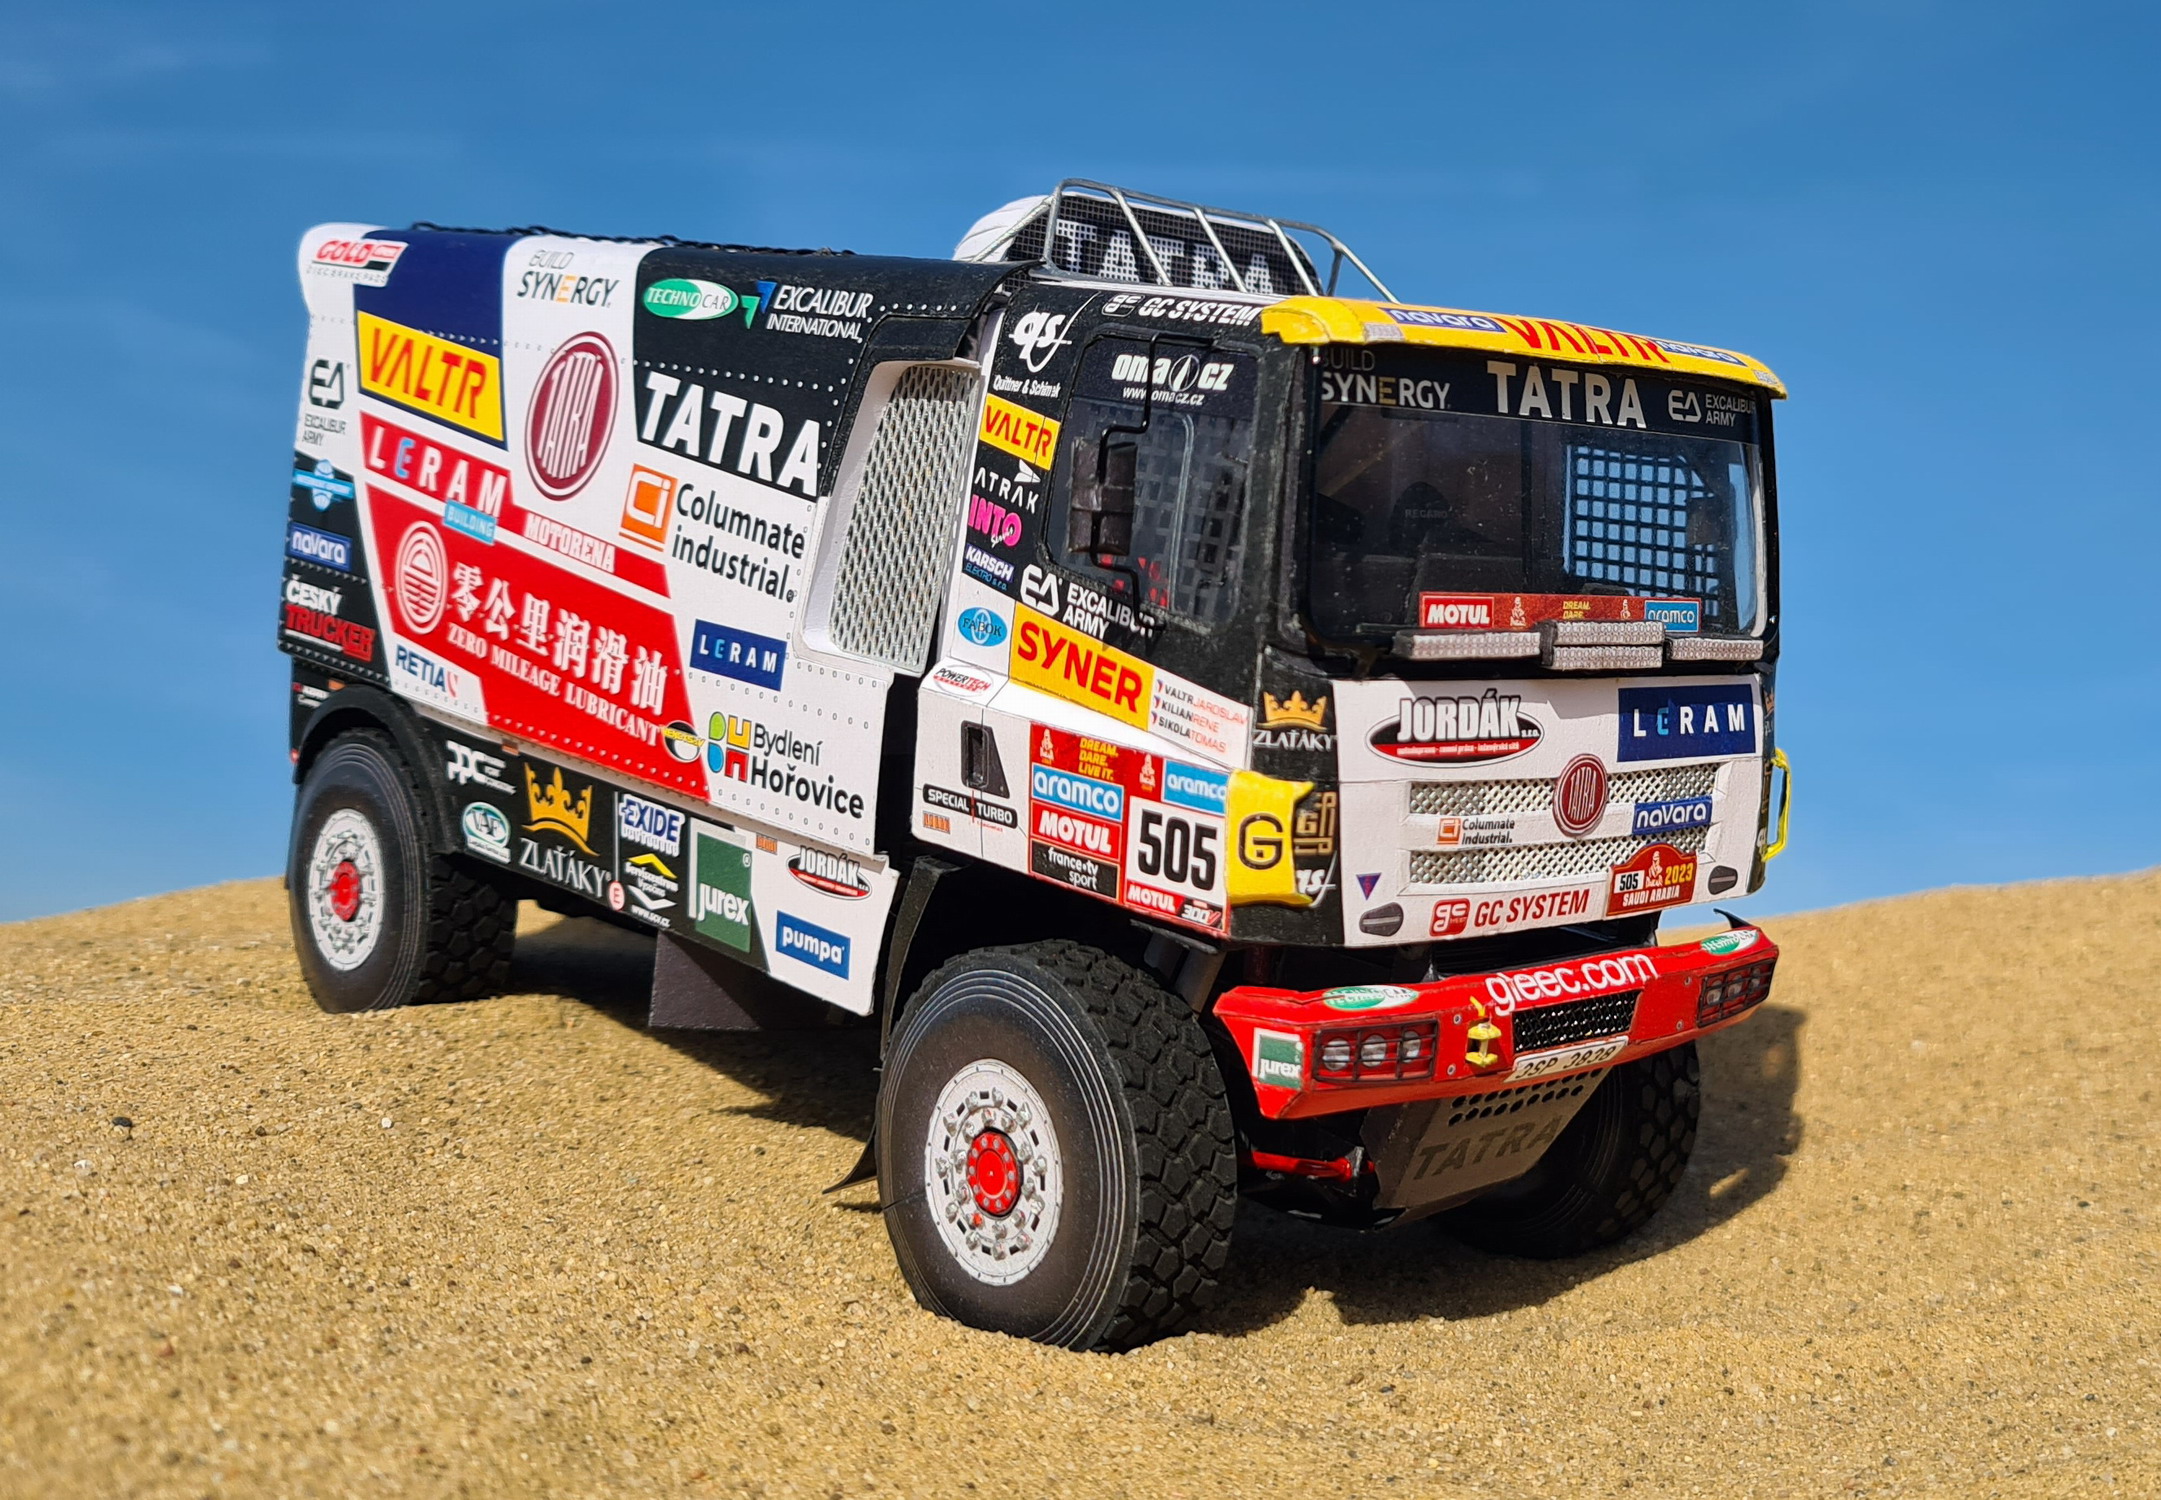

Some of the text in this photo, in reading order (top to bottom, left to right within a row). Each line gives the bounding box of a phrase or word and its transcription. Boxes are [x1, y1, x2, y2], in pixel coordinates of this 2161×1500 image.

[1056, 218, 1275, 295] TATRA
[517, 271, 619, 306] SYNERGY
[773, 285, 874, 318] EXCALIBUR
[766, 314, 861, 340] INTERNATIONAL
[1138, 297, 1175, 317] GC
[1168, 299, 1263, 326] SYSTEM
[1497, 317, 1670, 363] VALTR
[369, 327, 488, 419] VALTR
[1322, 371, 1450, 410] SYNERGY
[1486, 361, 1647, 429] TATRA
[641, 370, 820, 497] TATRA
[984, 405, 1053, 458] VALTR
[1705, 410, 1736, 428] ARMY
[369, 424, 508, 518] LERAM
[974, 466, 1040, 515] ATRAK
[447, 507, 495, 540] BUILDING
[676, 483, 806, 560] Columnate
[968, 494, 1022, 547] INTO
[523, 514, 617, 574] MOTORENA
[965, 546, 1015, 582] KARSCH
[286, 574, 342, 614] ČESKÝ
[1426, 604, 1491, 624] MOTUL
[284, 604, 376, 657] TRUCKER
[450, 562, 668, 716] 零公里润滑油
[963, 617, 1002, 637] FABOK
[1062, 604, 1110, 640] ARMY
[395, 644, 447, 693] RETIA
[699, 634, 778, 674] LERAM
[1017, 621, 1143, 714] SYNER
[447, 621, 488, 659] ZERO
[490, 643, 561, 697] MILEAGE
[564, 682, 661, 747] LUBRICANT
[1397, 688, 1521, 742] JORDÁK
[1632, 703, 1745, 738] LERAM
[753, 723, 824, 767] Bydlení
[751, 754, 865, 819] Hořovice
[928, 788, 1013, 824] SPECIAL TURBO
[1033, 771, 1120, 815] aramco
[623, 799, 680, 843] EXIDE
[1038, 810, 1112, 854] MOTUL
[1462, 817, 1516, 832] Columnate
[798, 846, 859, 888] JORDÁK
[1138, 808, 1218, 891] 505
[1069, 869, 1098, 891] sport
[1127, 884, 1176, 913] MOTUL
[1619, 863, 1694, 891] 505 2023
[1622, 885, 1680, 907] SAUDI ARABIA
[1474, 900, 1504, 928] GC
[1506, 889, 1591, 923] SYSTEM
[782, 926, 843, 964] pumpa
[1413, 1116, 1564, 1182] TATRA
